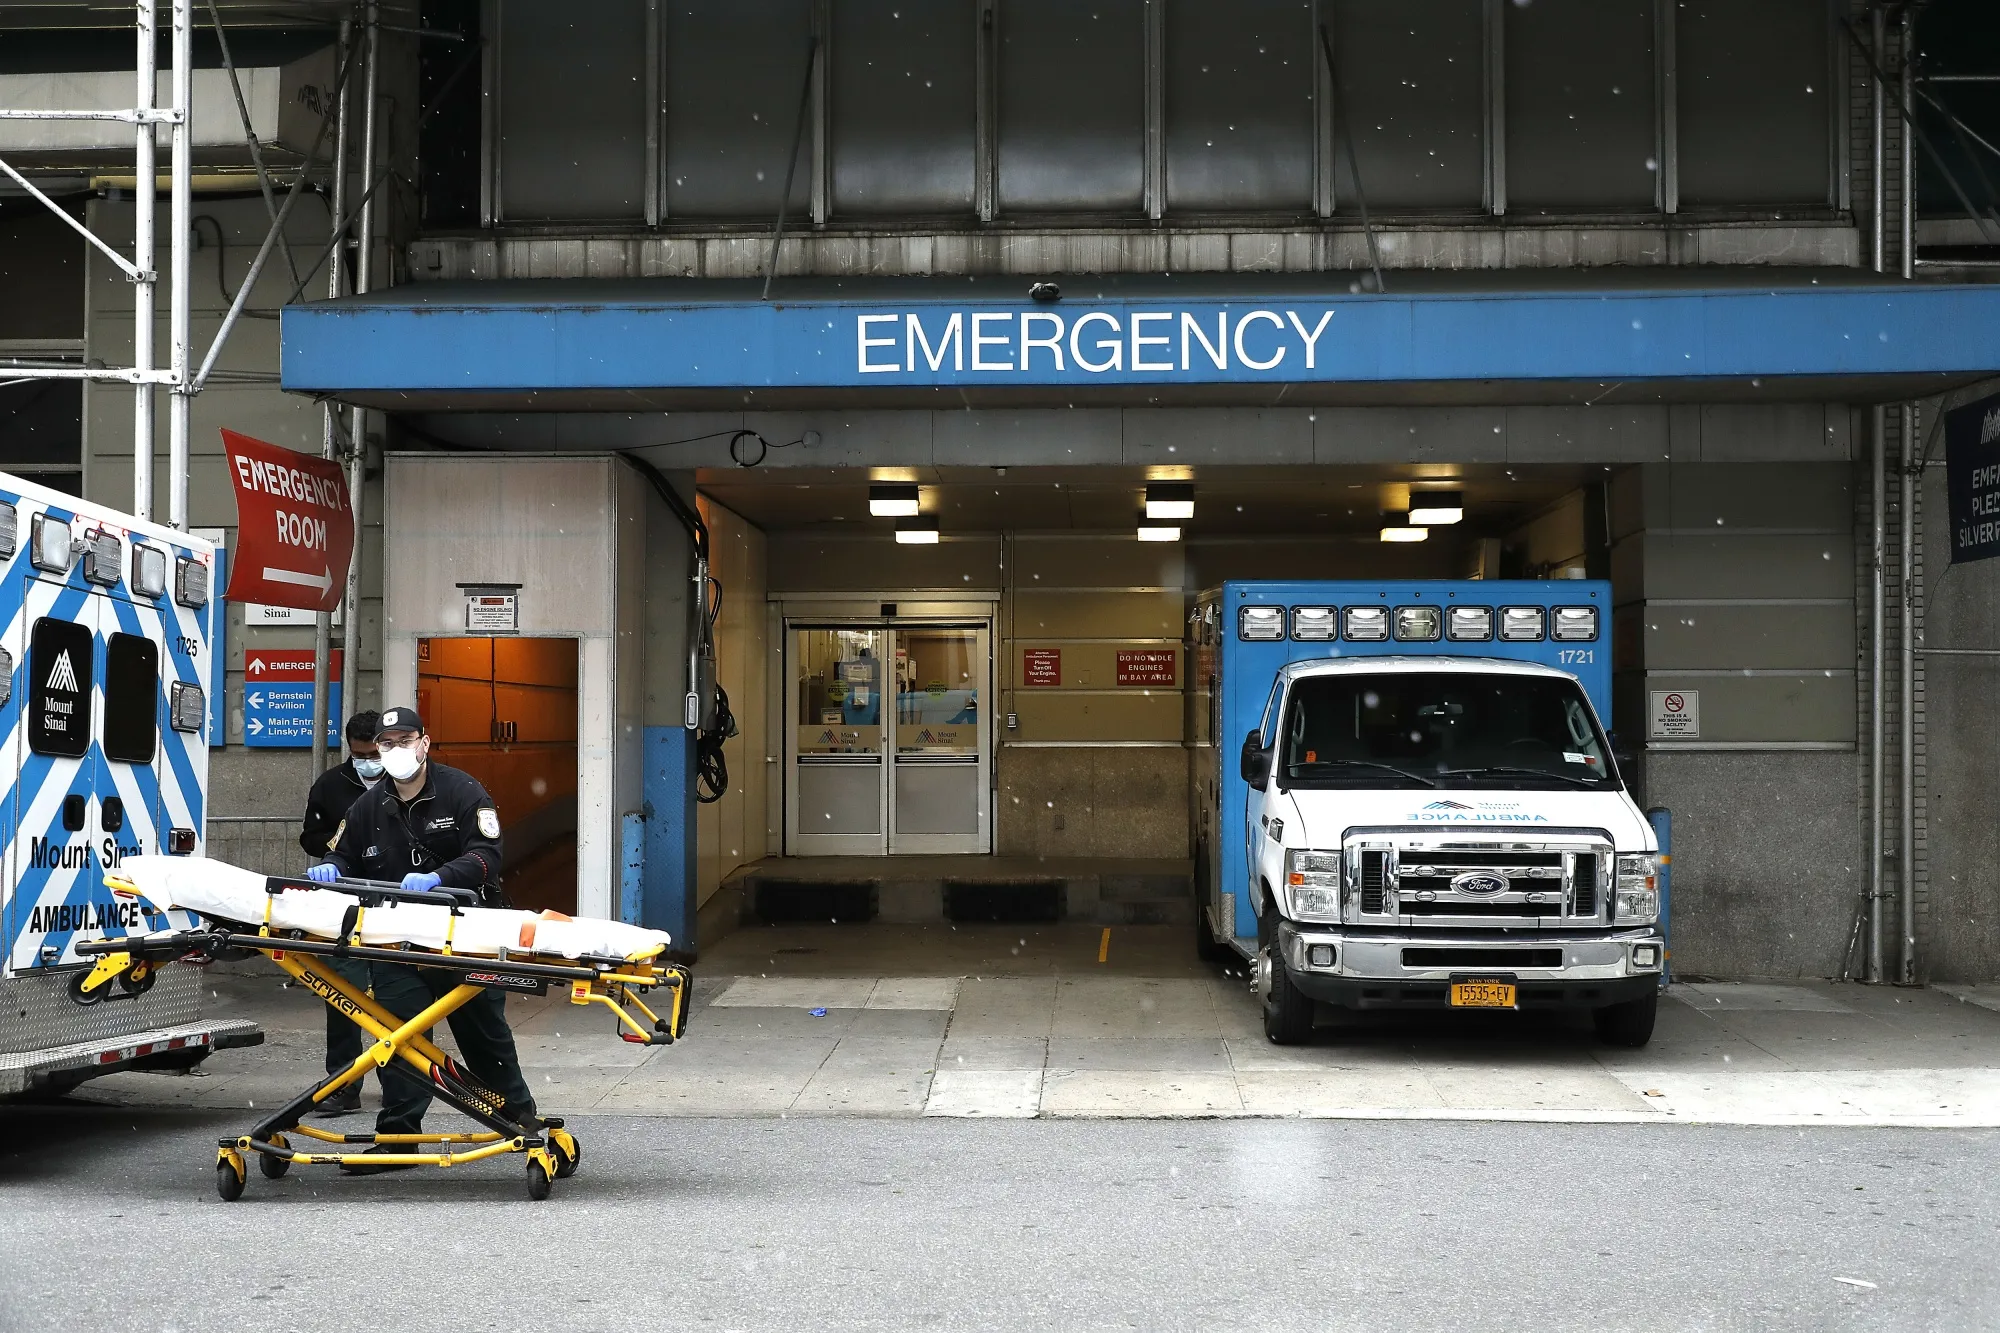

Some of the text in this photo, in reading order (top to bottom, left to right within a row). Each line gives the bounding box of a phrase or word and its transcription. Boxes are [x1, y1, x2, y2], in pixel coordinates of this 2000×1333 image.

[856, 310, 1335, 373] EMERGENCY
[234, 455, 342, 512] EMERGENCY
[276, 510, 327, 552] ROOM
[264, 608, 291, 618] Sinai
[176, 636, 198, 657] 1725
[1154, 654, 1173, 662] IDLE
[1558, 650, 1594, 664] 1721
[270, 662, 331, 670] EMERGEN
[268, 692, 312, 700] Bernstein
[44, 697, 74, 714] Mount
[44, 715, 67, 731] Sinai
[293, 718, 333, 726] Entre
[268, 728, 298, 736] Linsky
[31, 836, 91, 869] Mount
[1468, 879, 1494, 890] Ford
[29, 903, 139, 933] AMBULANCE
[299, 971, 362, 1016] stryker
